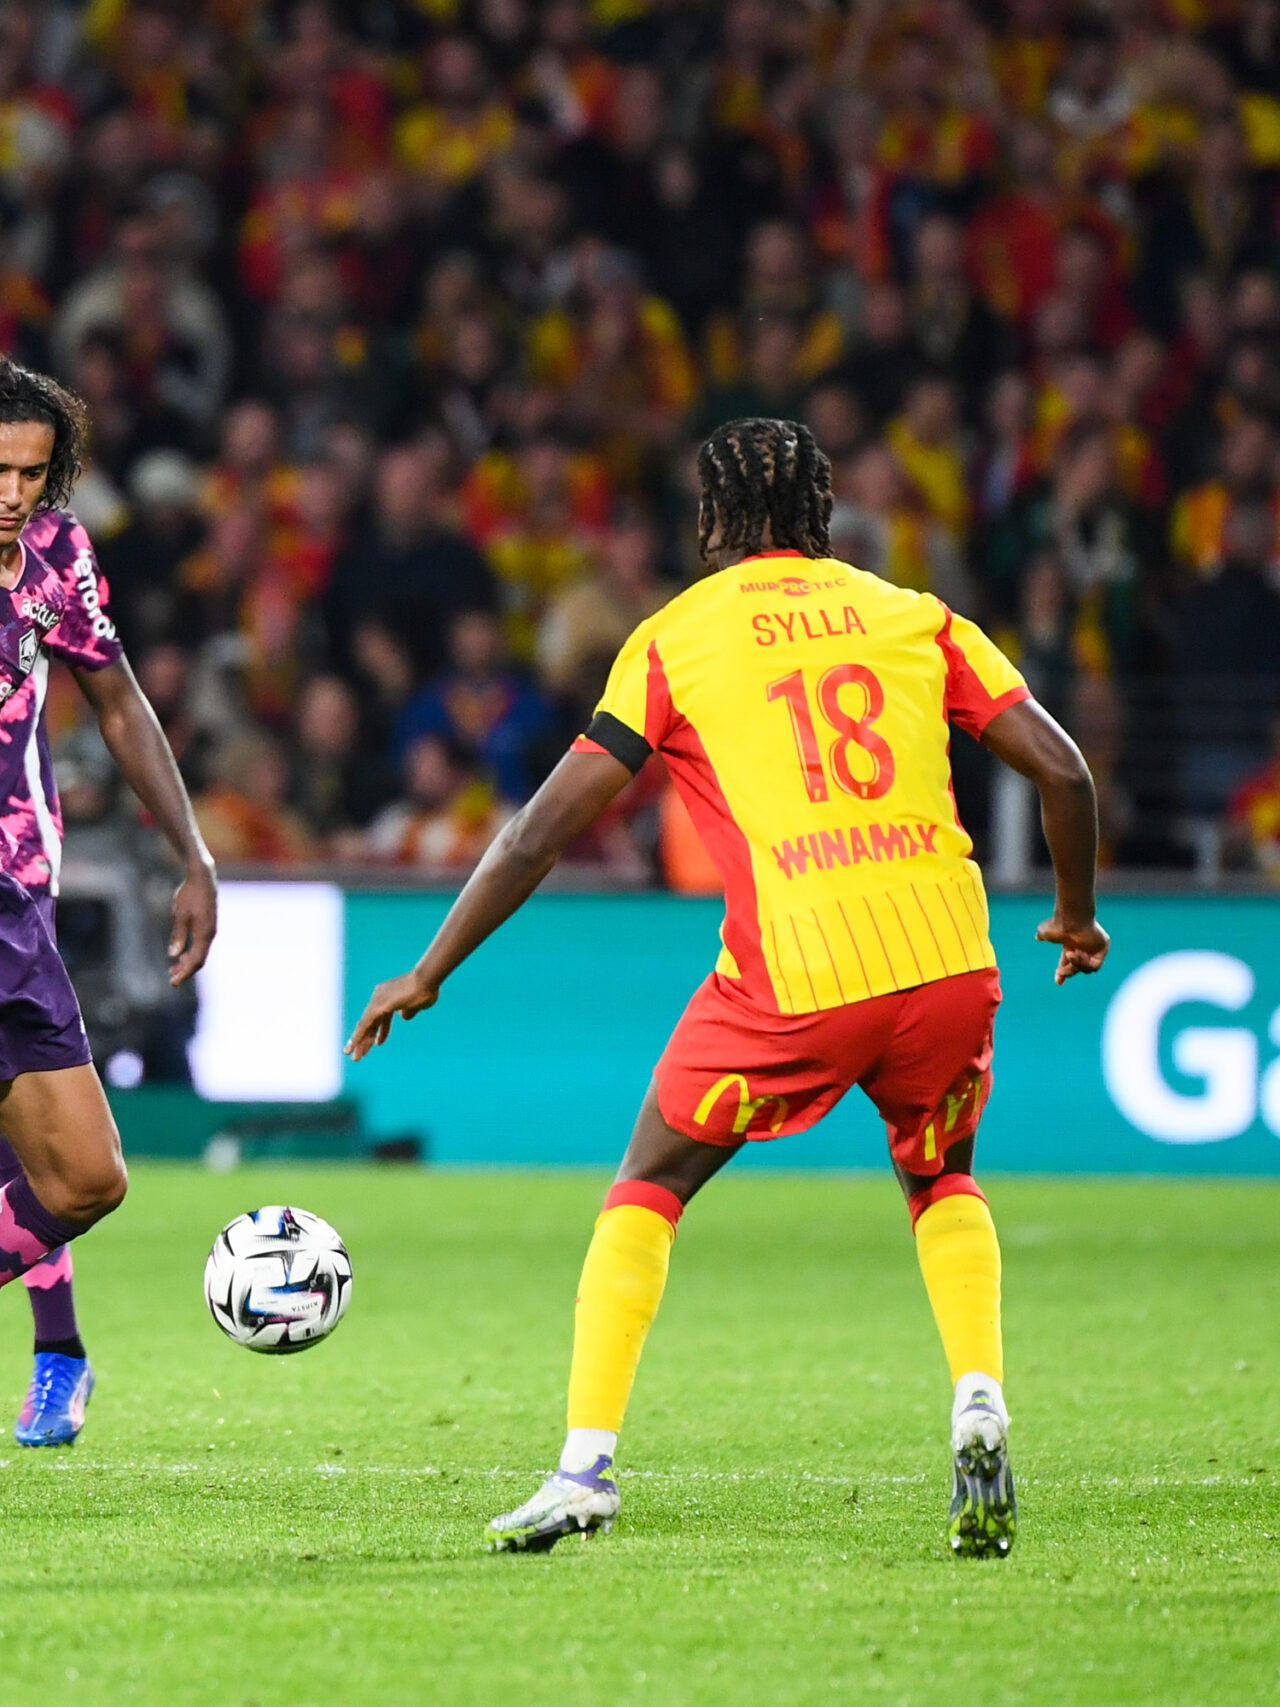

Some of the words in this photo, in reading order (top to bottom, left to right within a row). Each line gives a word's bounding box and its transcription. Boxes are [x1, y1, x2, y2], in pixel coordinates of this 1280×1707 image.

[21, 598, 59, 627] actua
[752, 605, 867, 647] SYLLA
[765, 662, 897, 804] 18
[1099, 948, 1280, 1144] G
